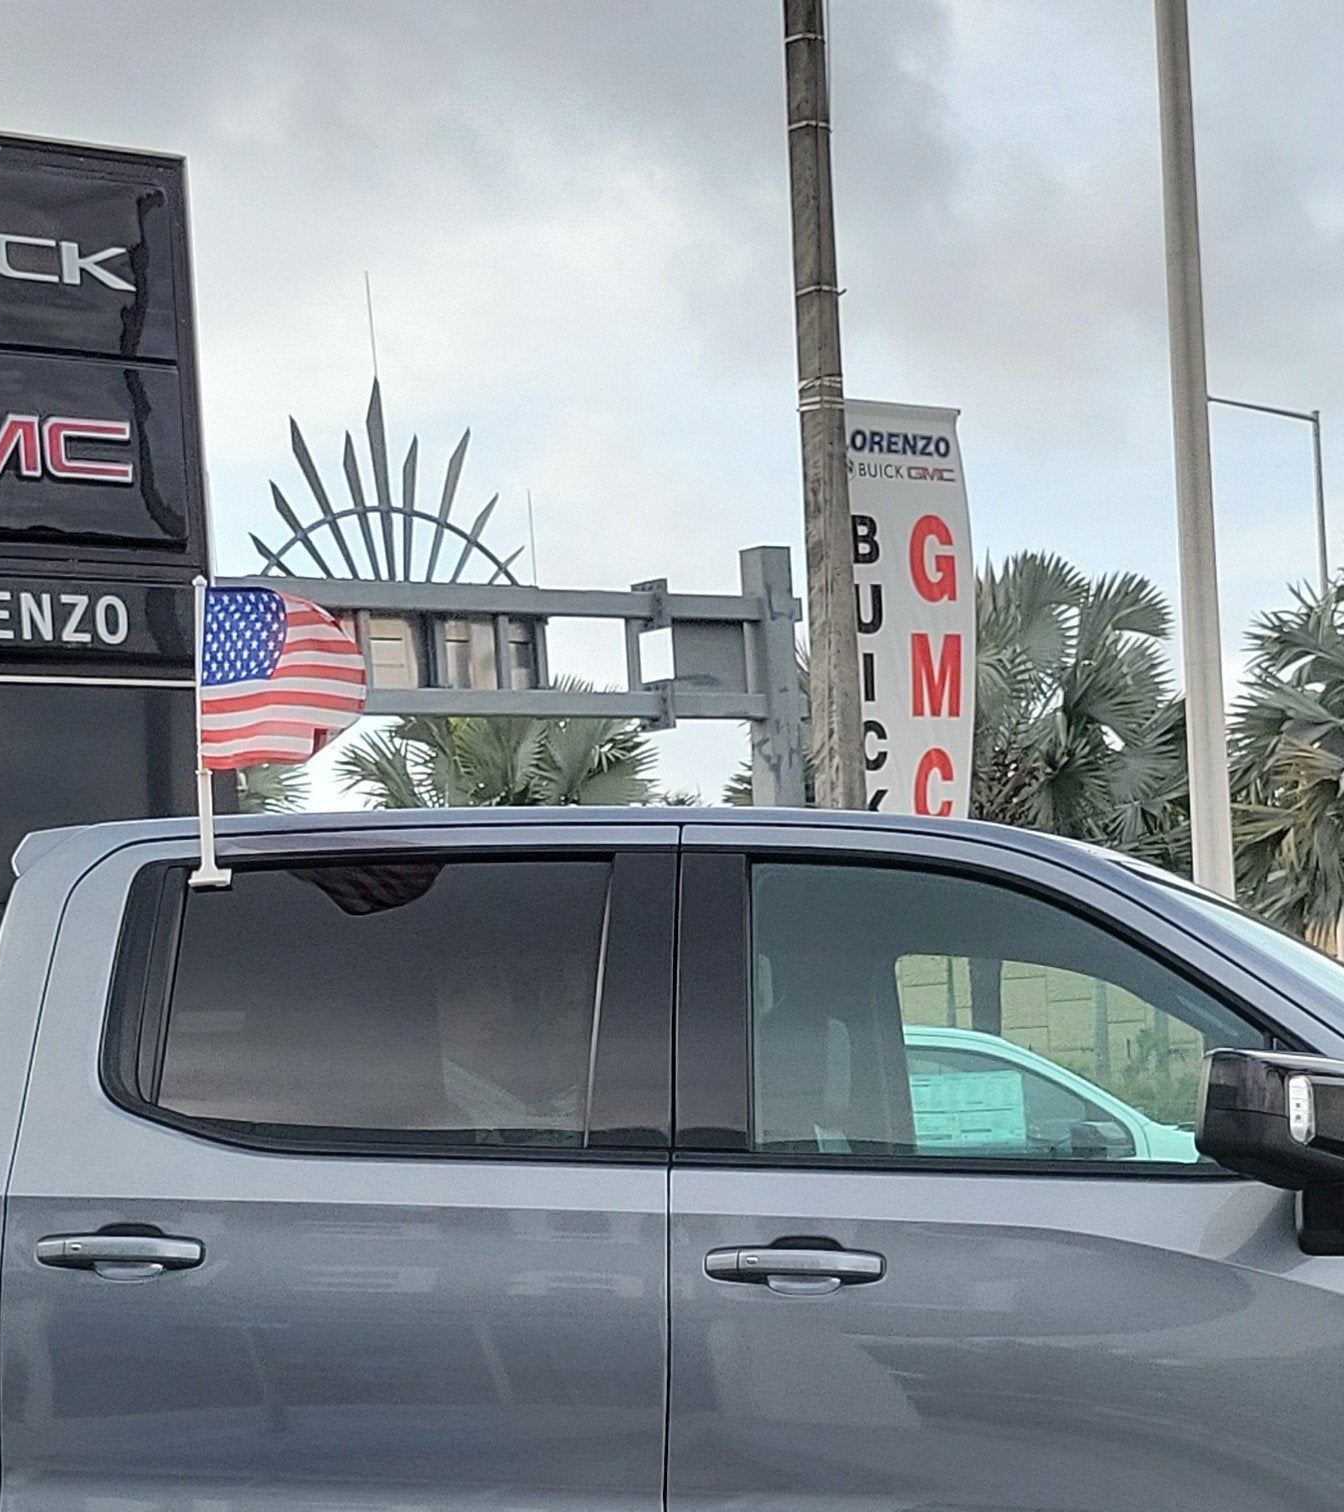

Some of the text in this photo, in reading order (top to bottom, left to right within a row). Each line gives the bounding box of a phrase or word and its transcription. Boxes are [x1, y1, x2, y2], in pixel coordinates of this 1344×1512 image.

[850, 429, 950, 458] ORENZO
[859, 462, 955, 482] BUICK GMC
[910, 514, 961, 817] GMC
